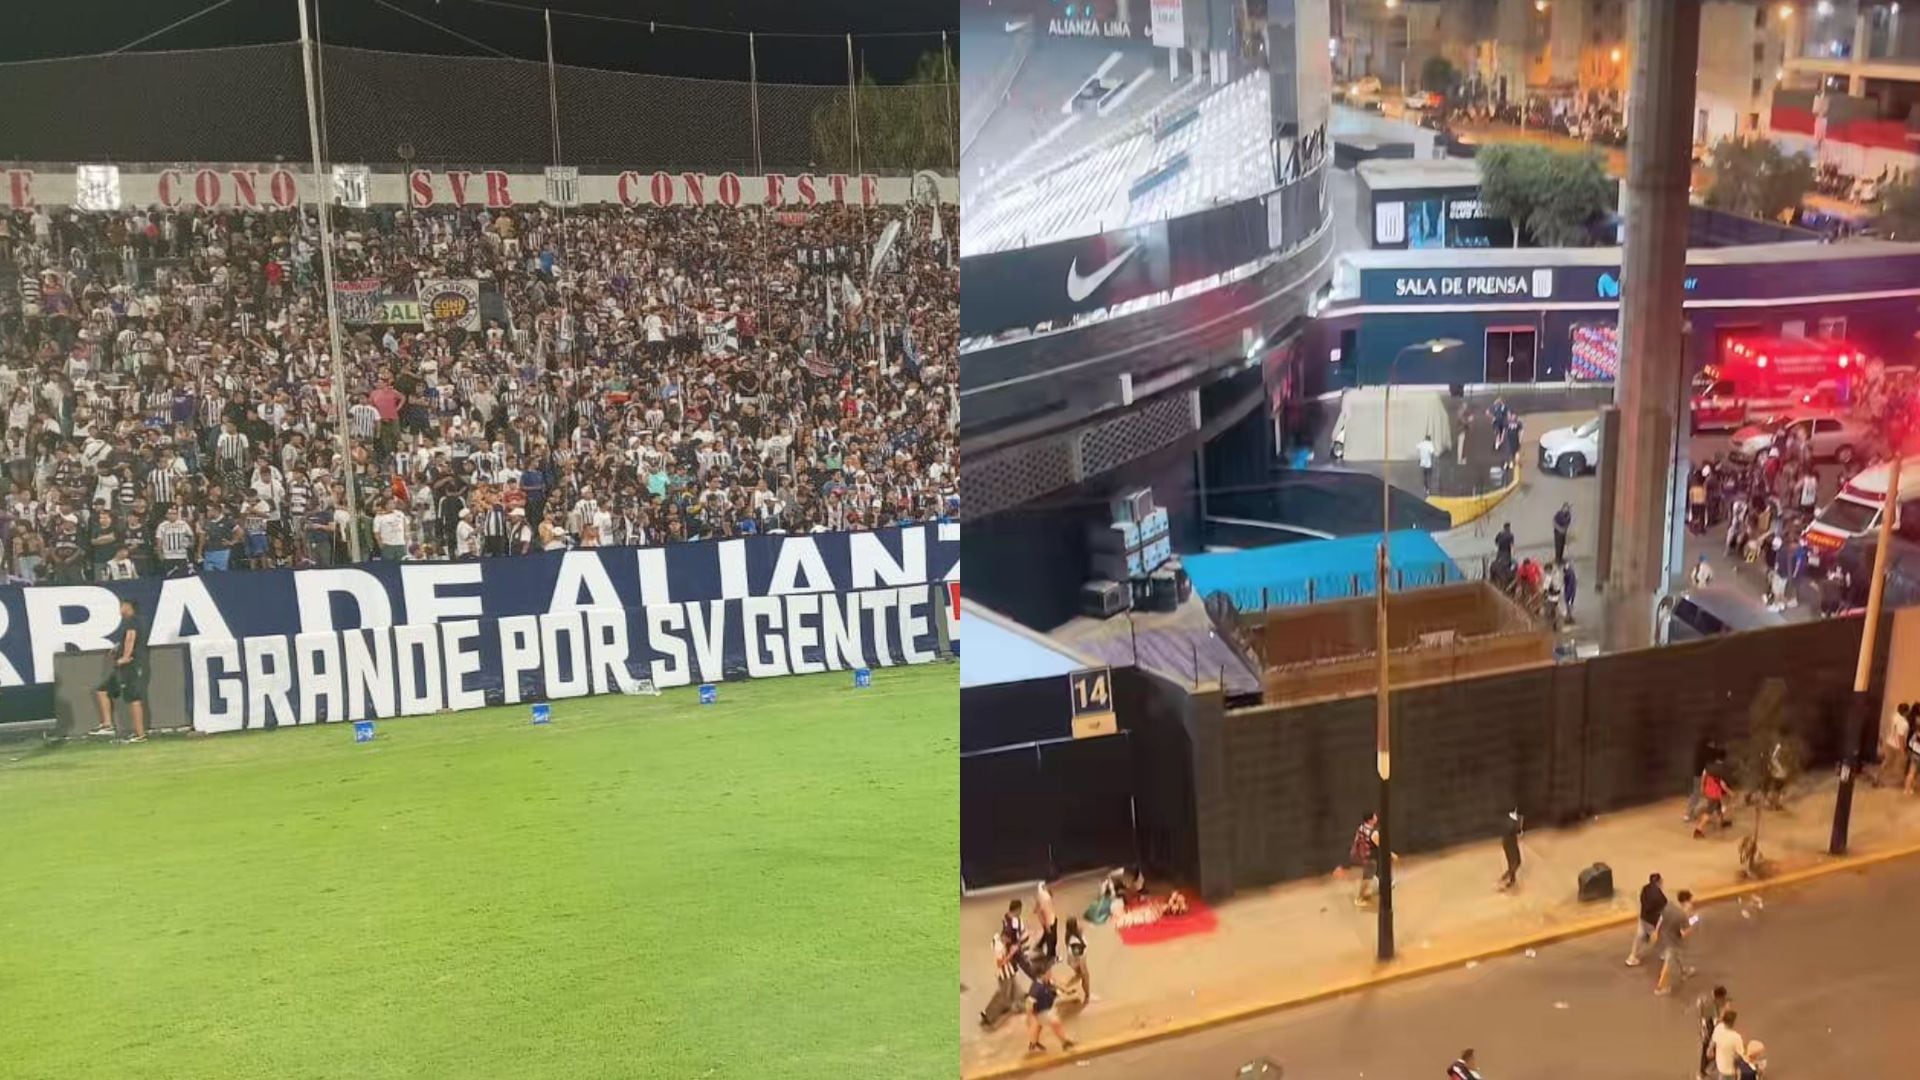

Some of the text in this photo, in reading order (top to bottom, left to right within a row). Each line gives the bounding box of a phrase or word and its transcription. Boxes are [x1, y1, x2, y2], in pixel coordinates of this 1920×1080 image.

[1049, 19, 1131, 38] ALIANZA LIMA
[158, 169, 515, 209] CONO SVR
[617, 170, 880, 210] CONO ESTE
[1396, 275, 1528, 297] SALA DE PRENSA
[294, 563, 484, 635] DE
[189, 584, 936, 734] GRANDE POR SV GENTE
[1074, 675, 1108, 709] 14
